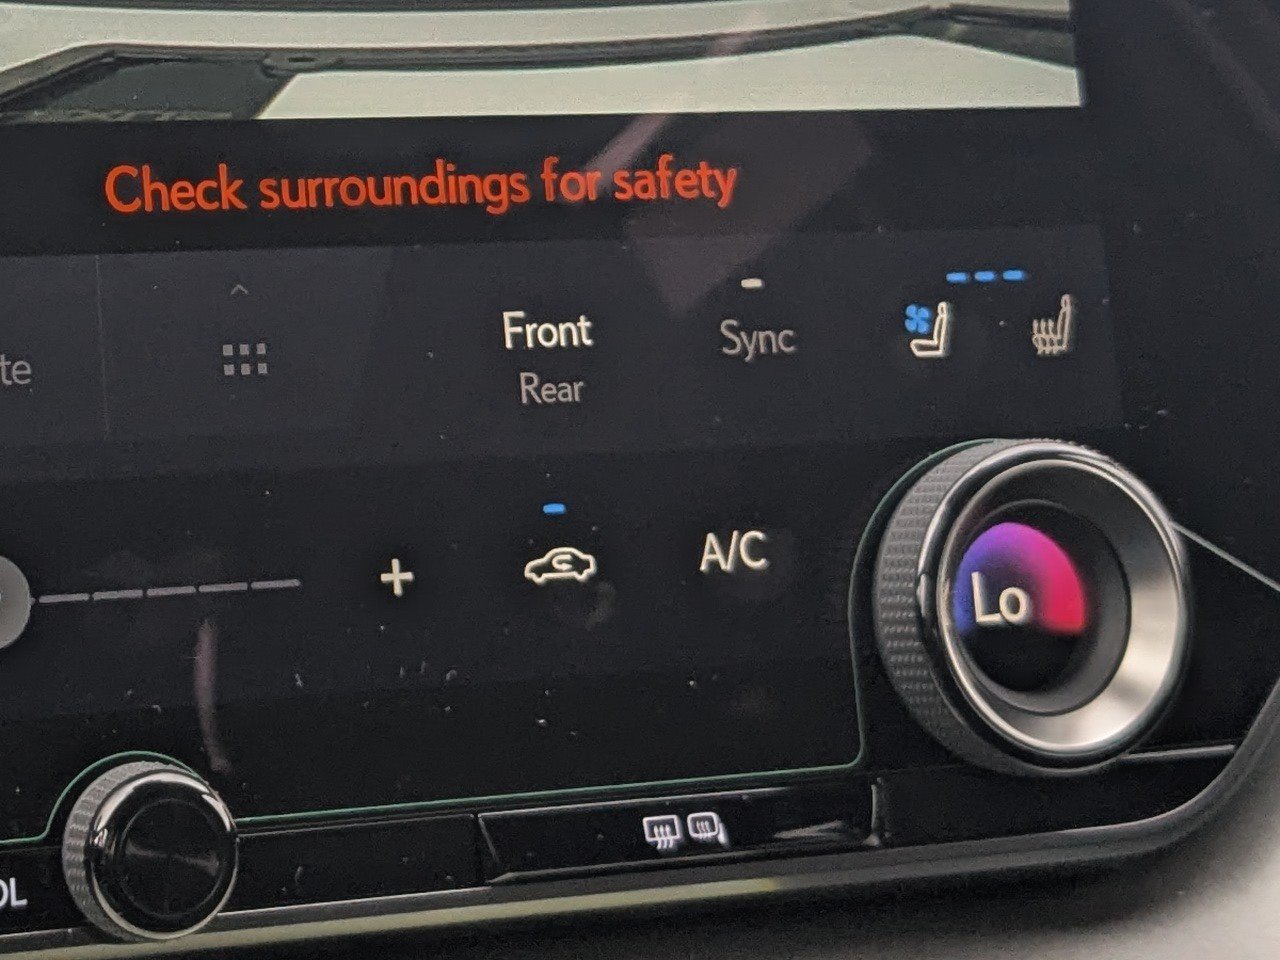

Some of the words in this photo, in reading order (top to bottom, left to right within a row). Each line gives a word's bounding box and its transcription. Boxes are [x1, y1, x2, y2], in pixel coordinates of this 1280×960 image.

[104, 163, 248, 213] Check
[259, 158, 531, 215] surroundings
[540, 156, 604, 202] for
[613, 153, 737, 208] safety
[502, 310, 593, 349] Front
[720, 319, 795, 362] Sync
[519, 371, 584, 404] Rear
[699, 530, 768, 572] A/C
[971, 571, 1030, 624] Lo
